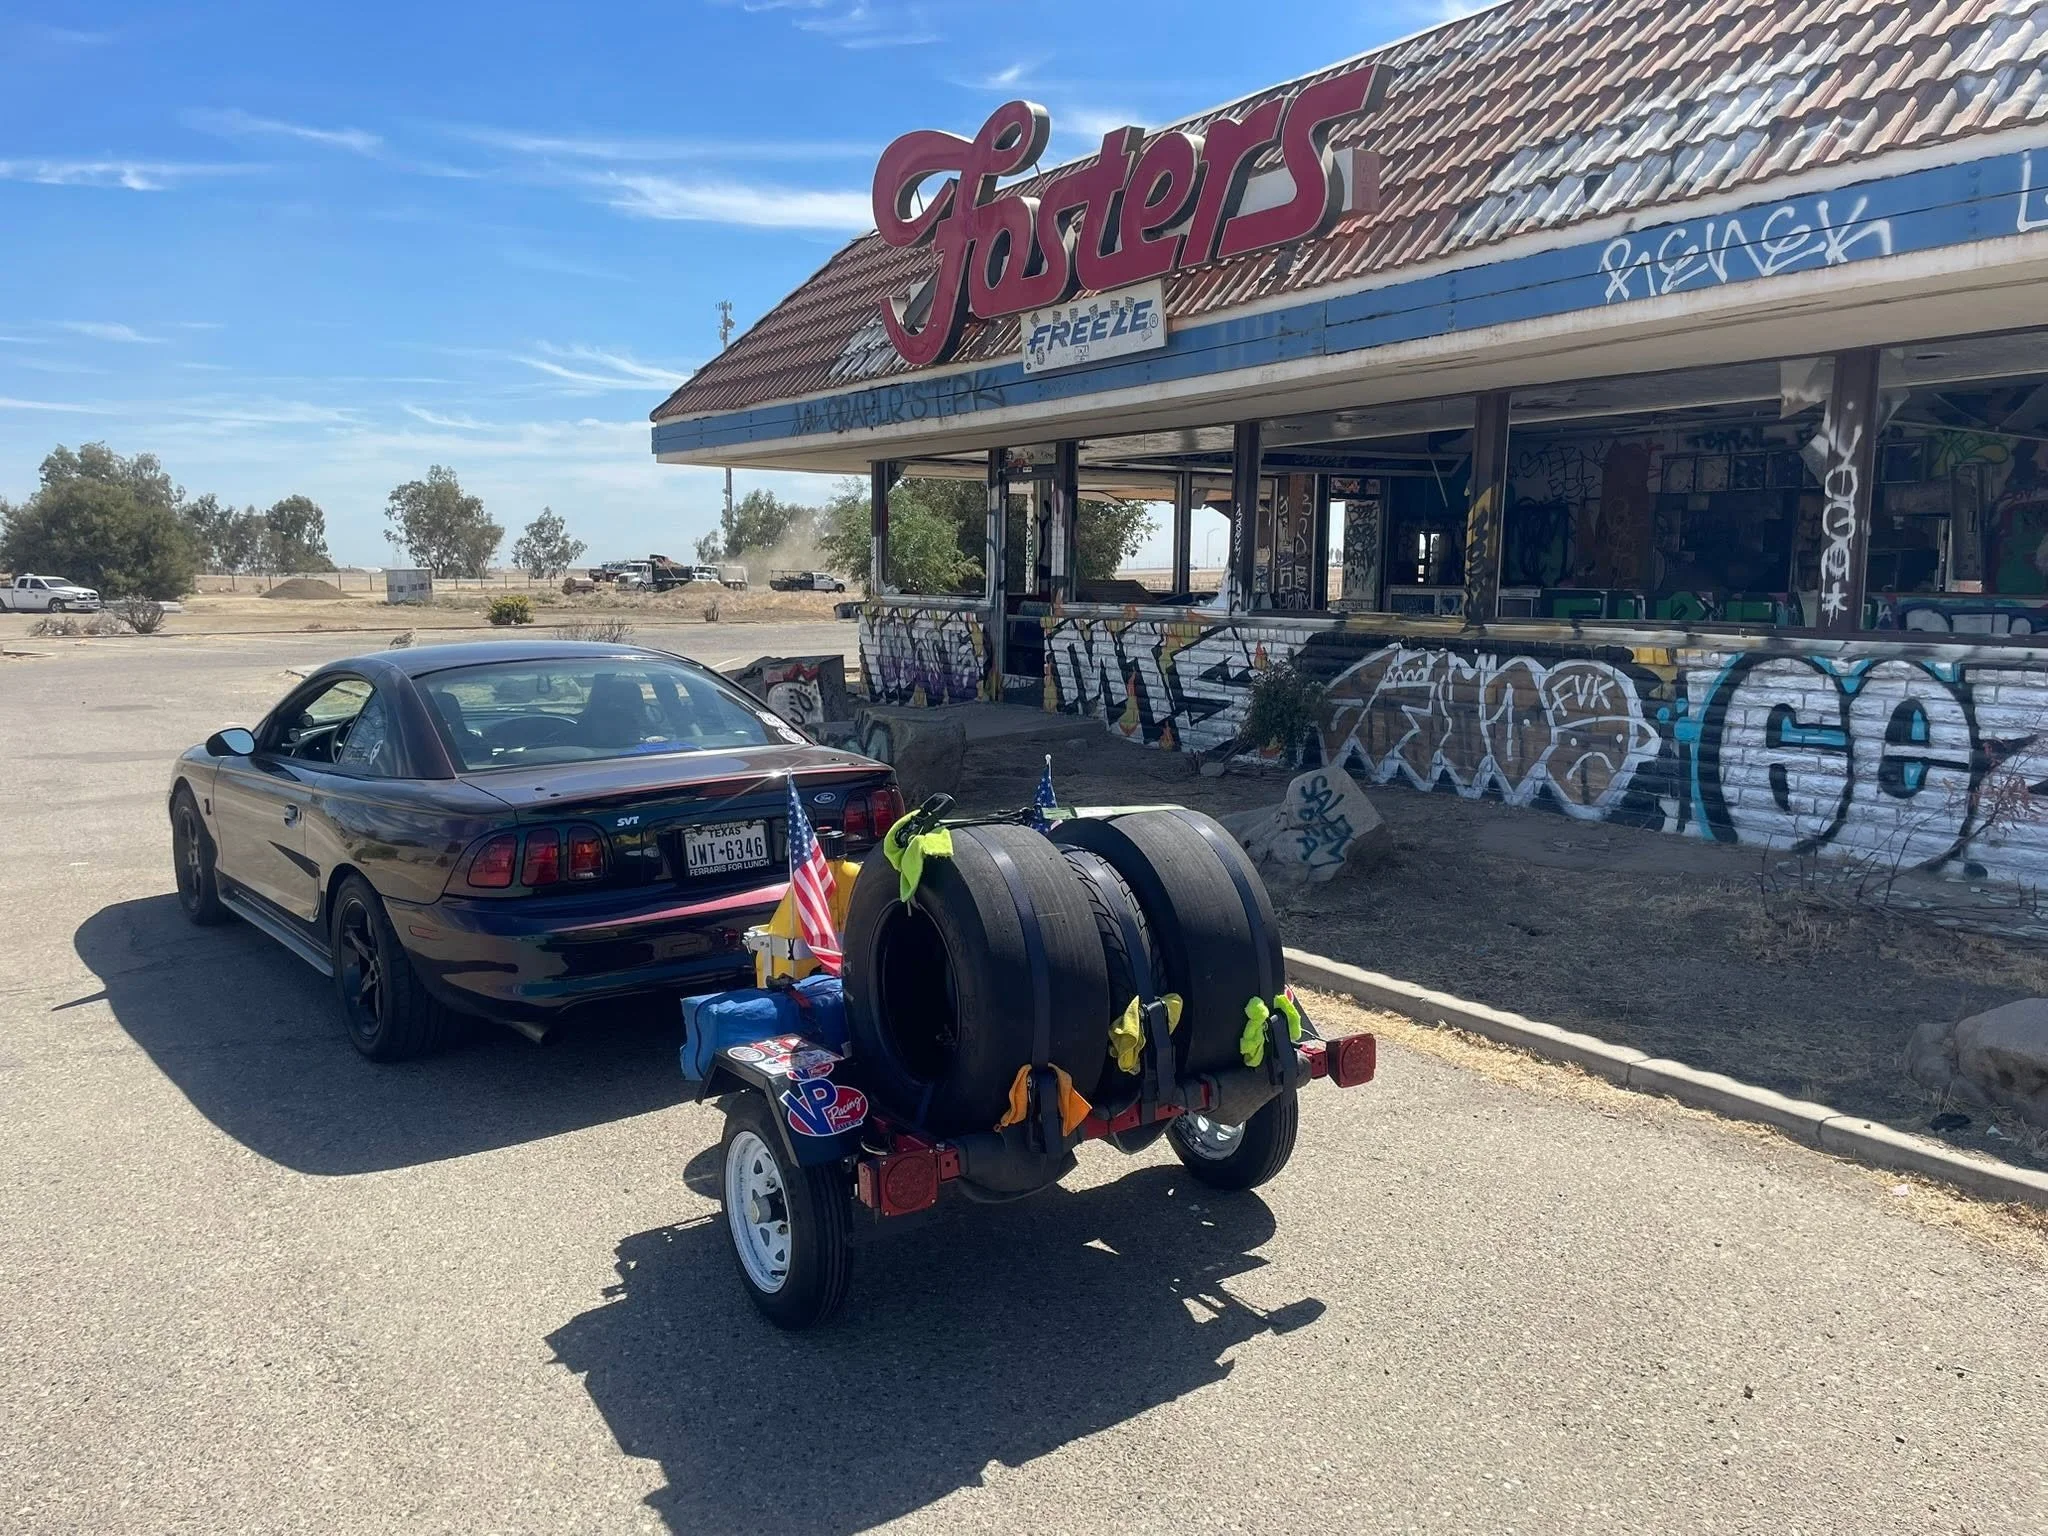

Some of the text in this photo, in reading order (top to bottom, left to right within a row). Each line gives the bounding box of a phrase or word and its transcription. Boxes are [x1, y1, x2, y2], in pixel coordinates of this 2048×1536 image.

[872, 64, 1384, 366] Fosters
[1027, 299, 1154, 355] FREEZE
[617, 815, 640, 827] SVT
[709, 826, 741, 838] TEXAS
[689, 857, 770, 877] FERRARIS FOR LUNCH
[780, 1078, 865, 1136] VP Racing
